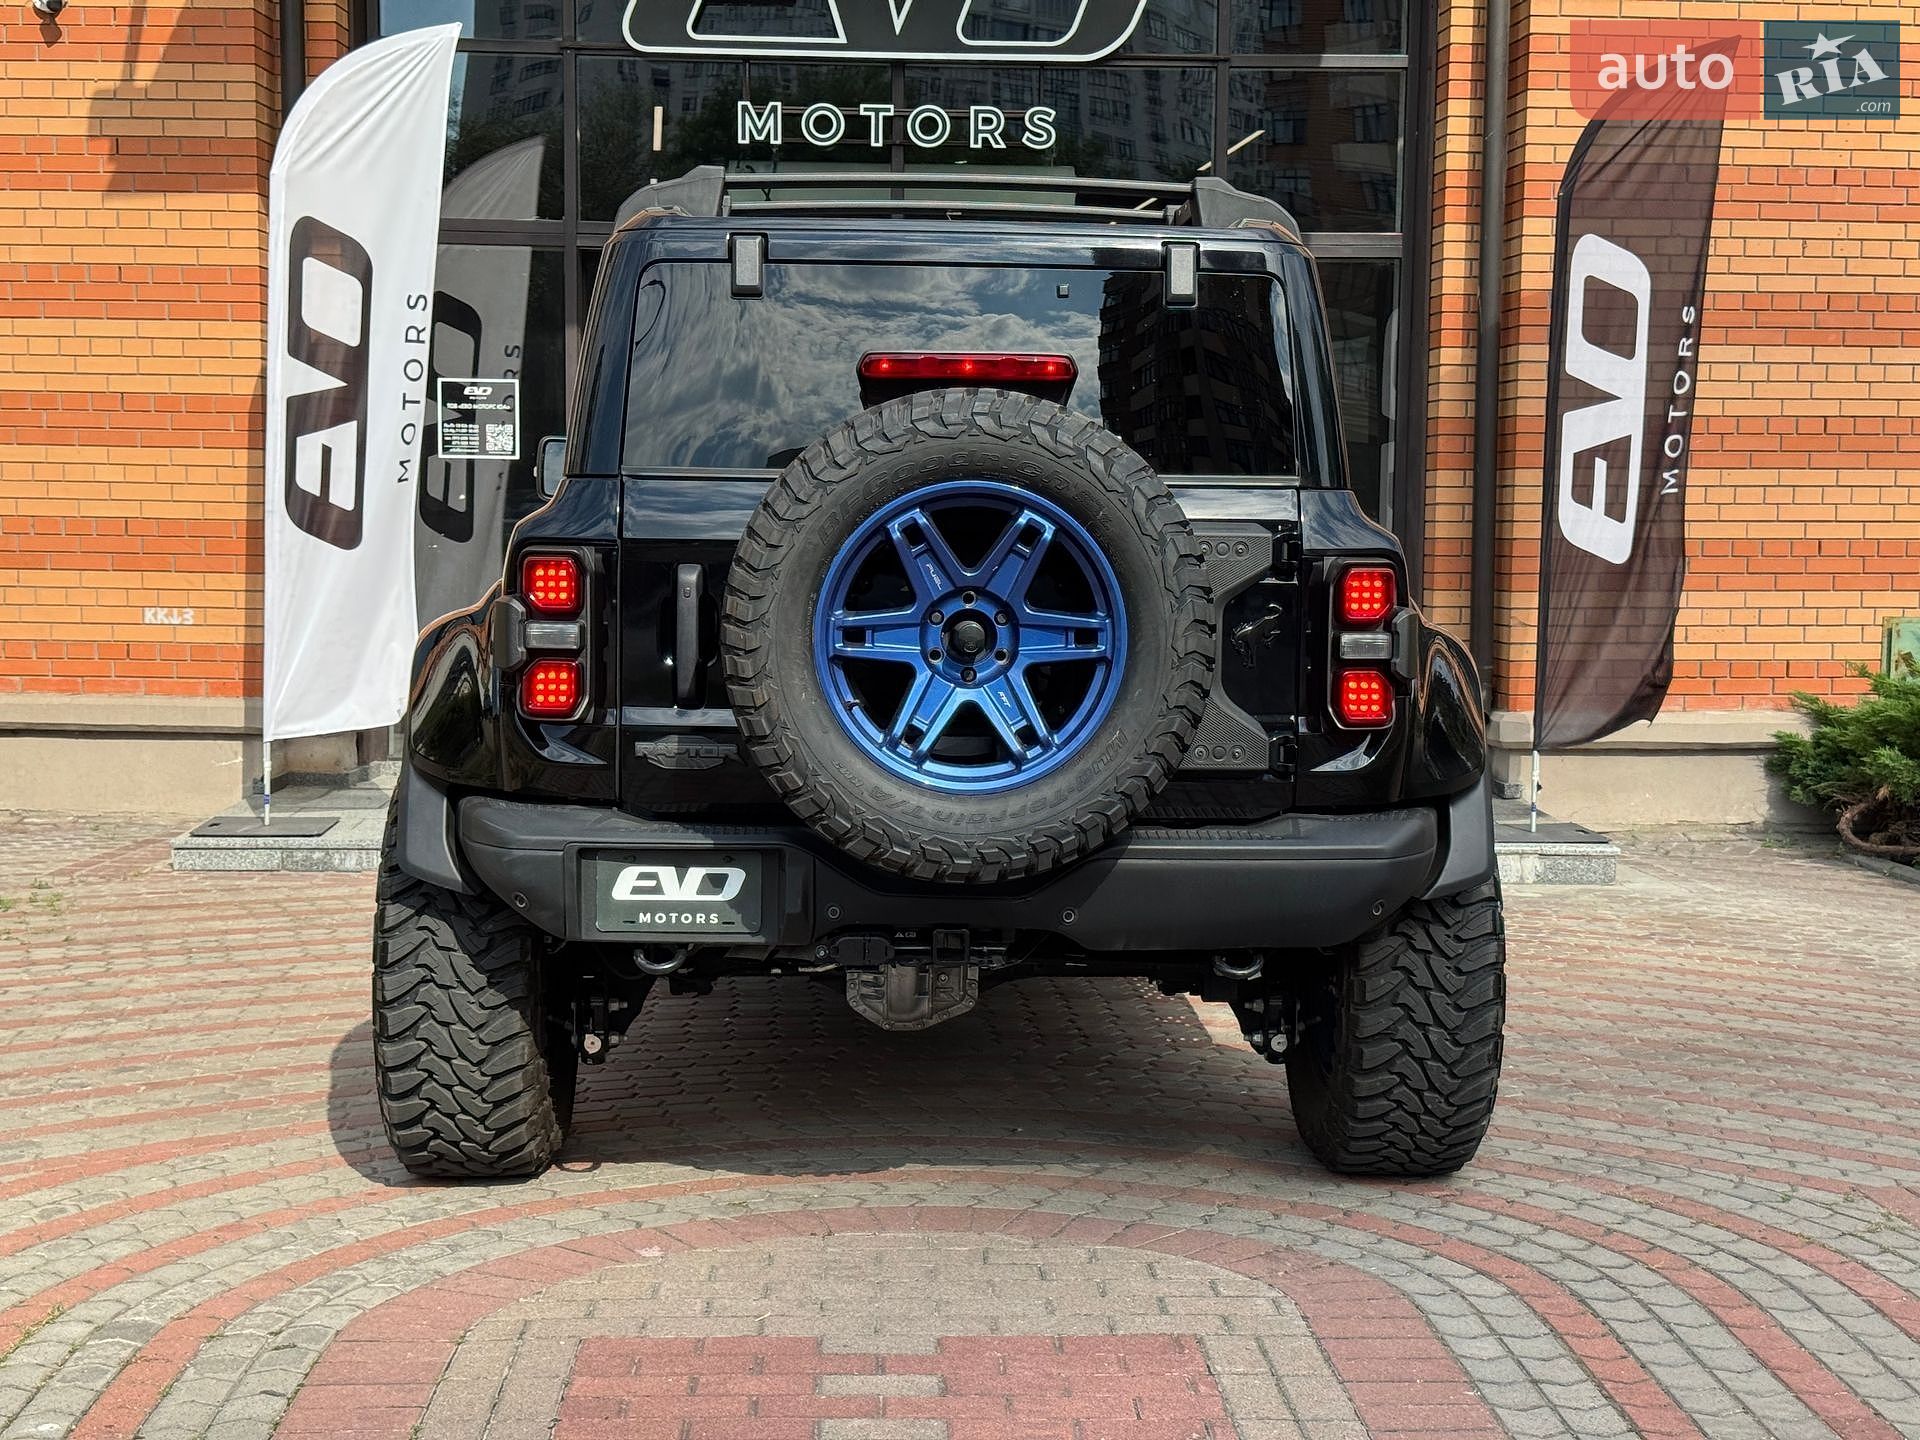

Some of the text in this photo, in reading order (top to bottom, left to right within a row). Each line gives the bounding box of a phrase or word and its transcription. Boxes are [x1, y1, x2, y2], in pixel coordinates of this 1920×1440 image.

[737, 100, 1057, 150] MOTORS
[285, 215, 373, 551] EVO
[397, 293, 428, 483] MOTORS
[1558, 233, 1651, 565] EVO
[1661, 305, 1696, 495] MOTORS
[611, 866, 747, 901] EVO
[639, 912, 719, 925] MOTORS
